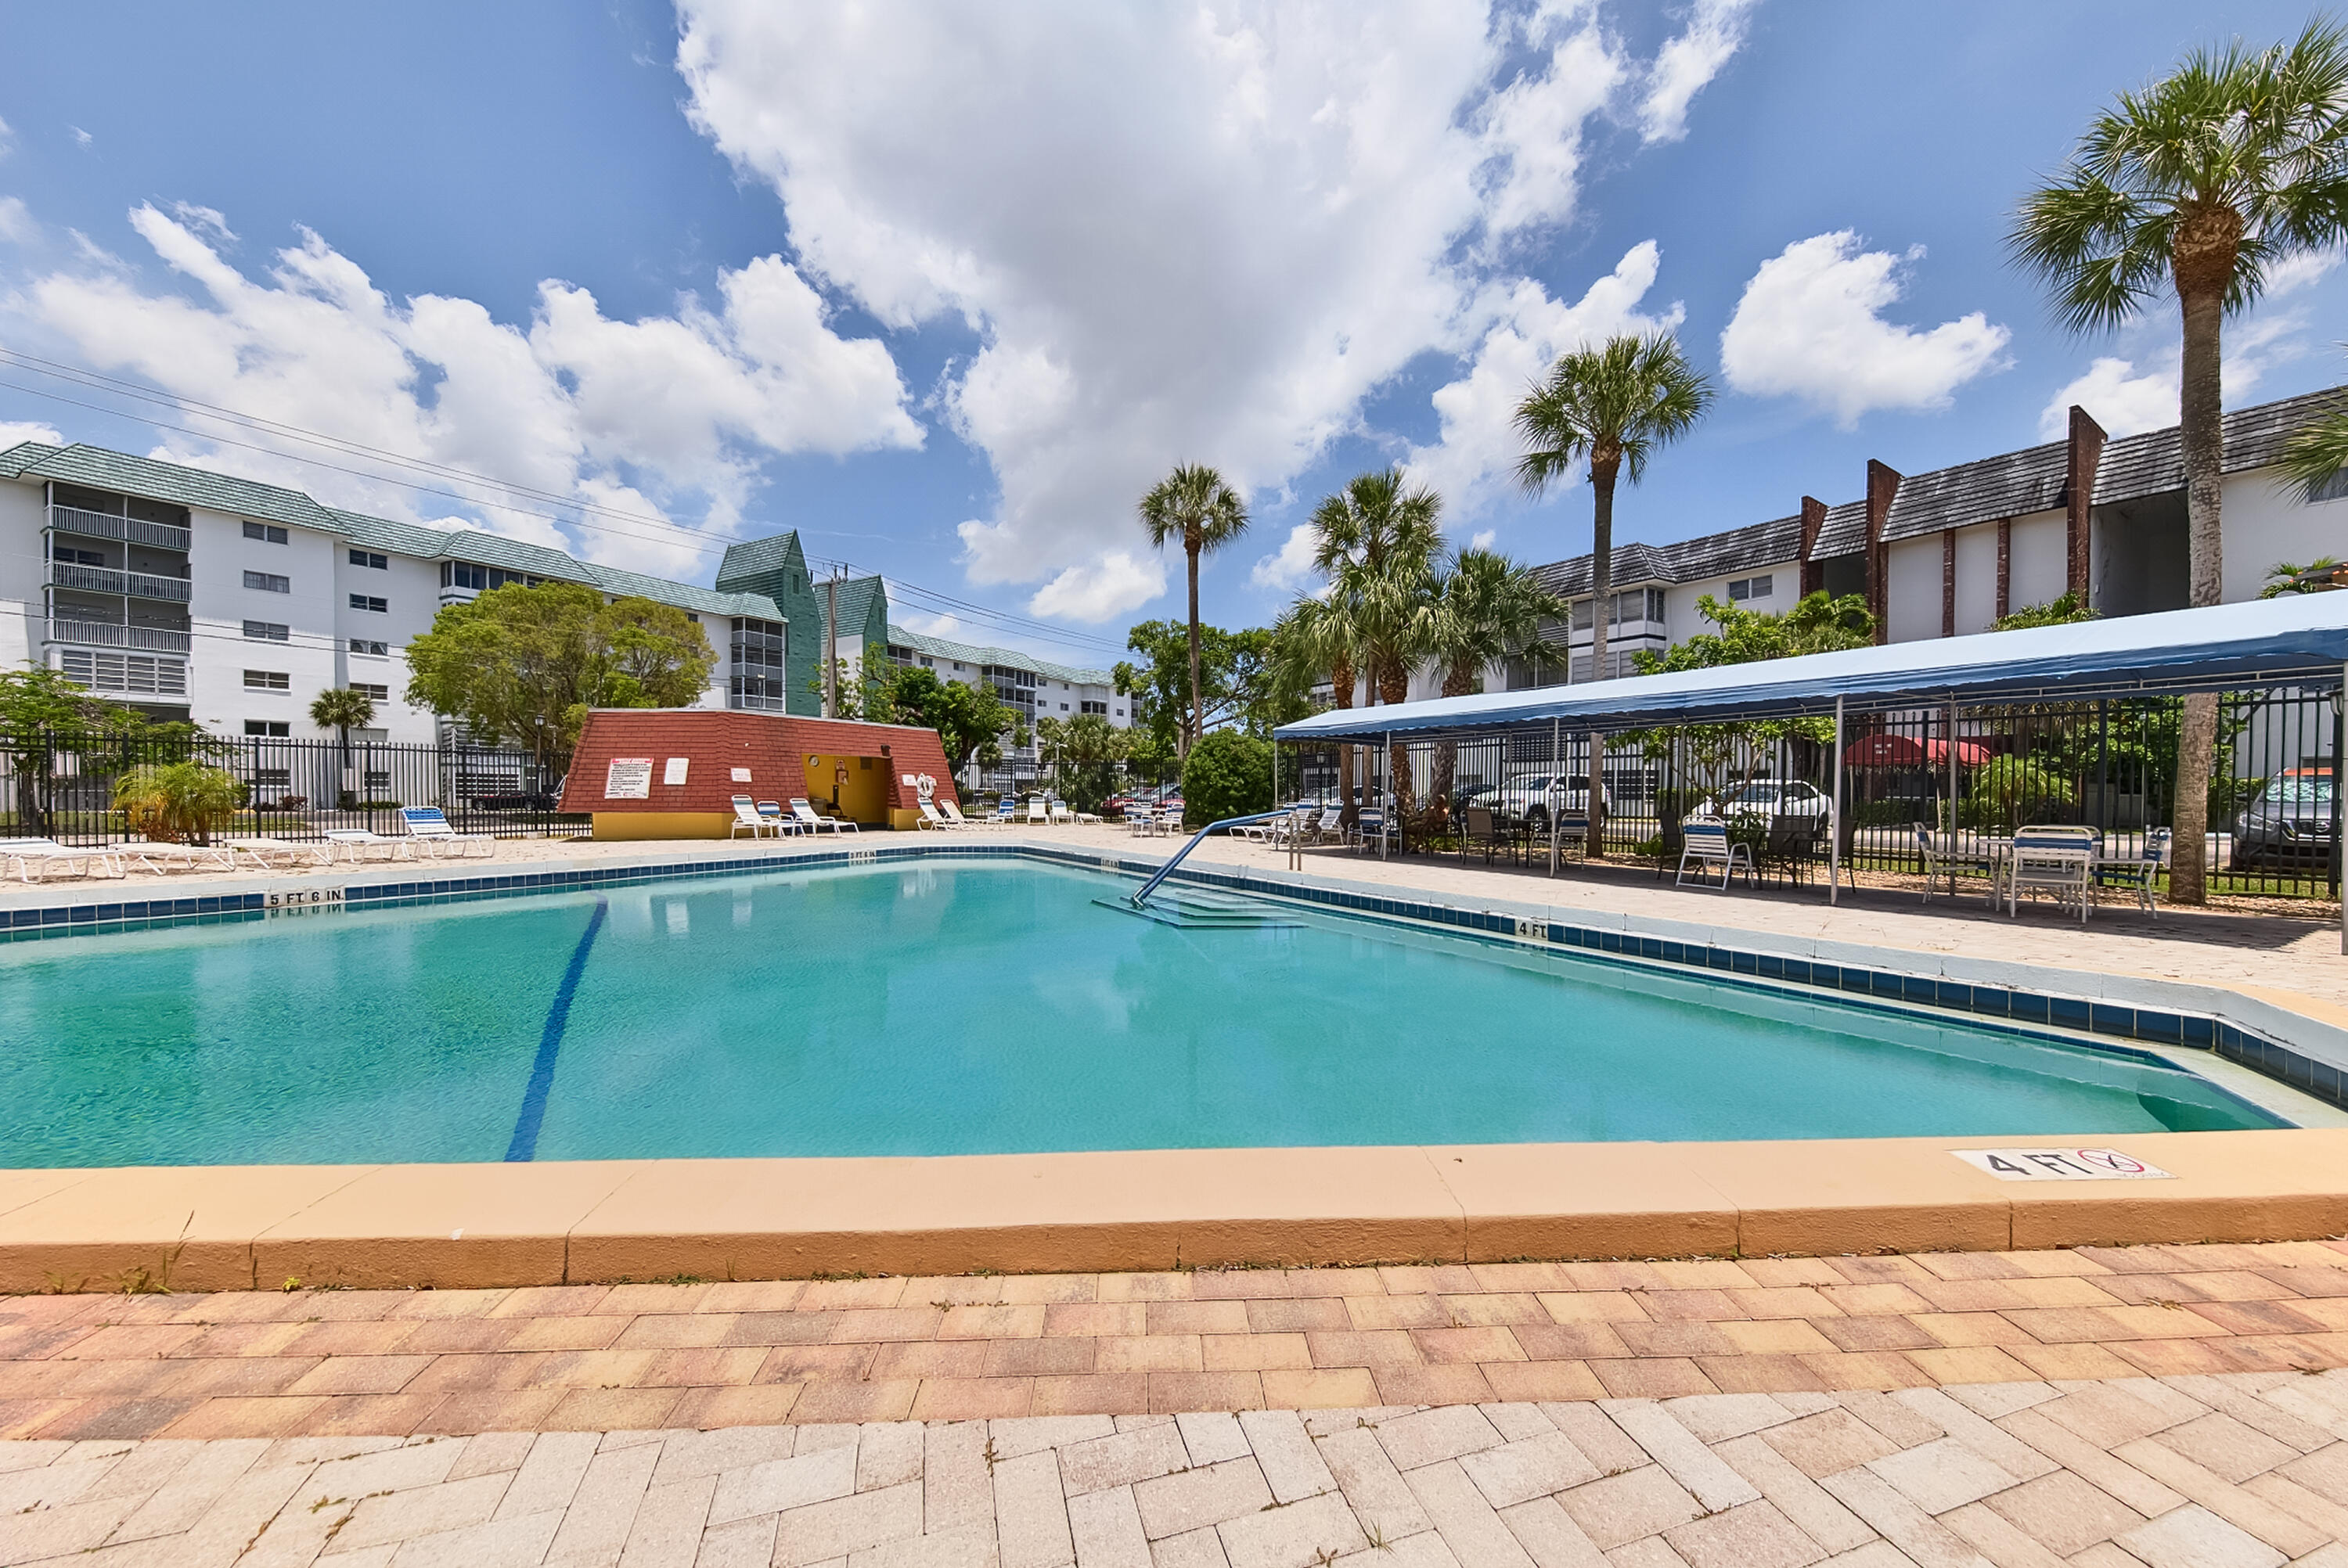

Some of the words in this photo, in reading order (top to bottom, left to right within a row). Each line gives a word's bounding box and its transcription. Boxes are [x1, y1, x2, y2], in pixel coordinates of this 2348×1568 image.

[270, 894, 279, 905] 5
[312, 891, 320, 902] 6
[1519, 922, 1528, 935] 4
[1986, 1153, 2033, 1176] 4
[2022, 1153, 2094, 1175] FT
